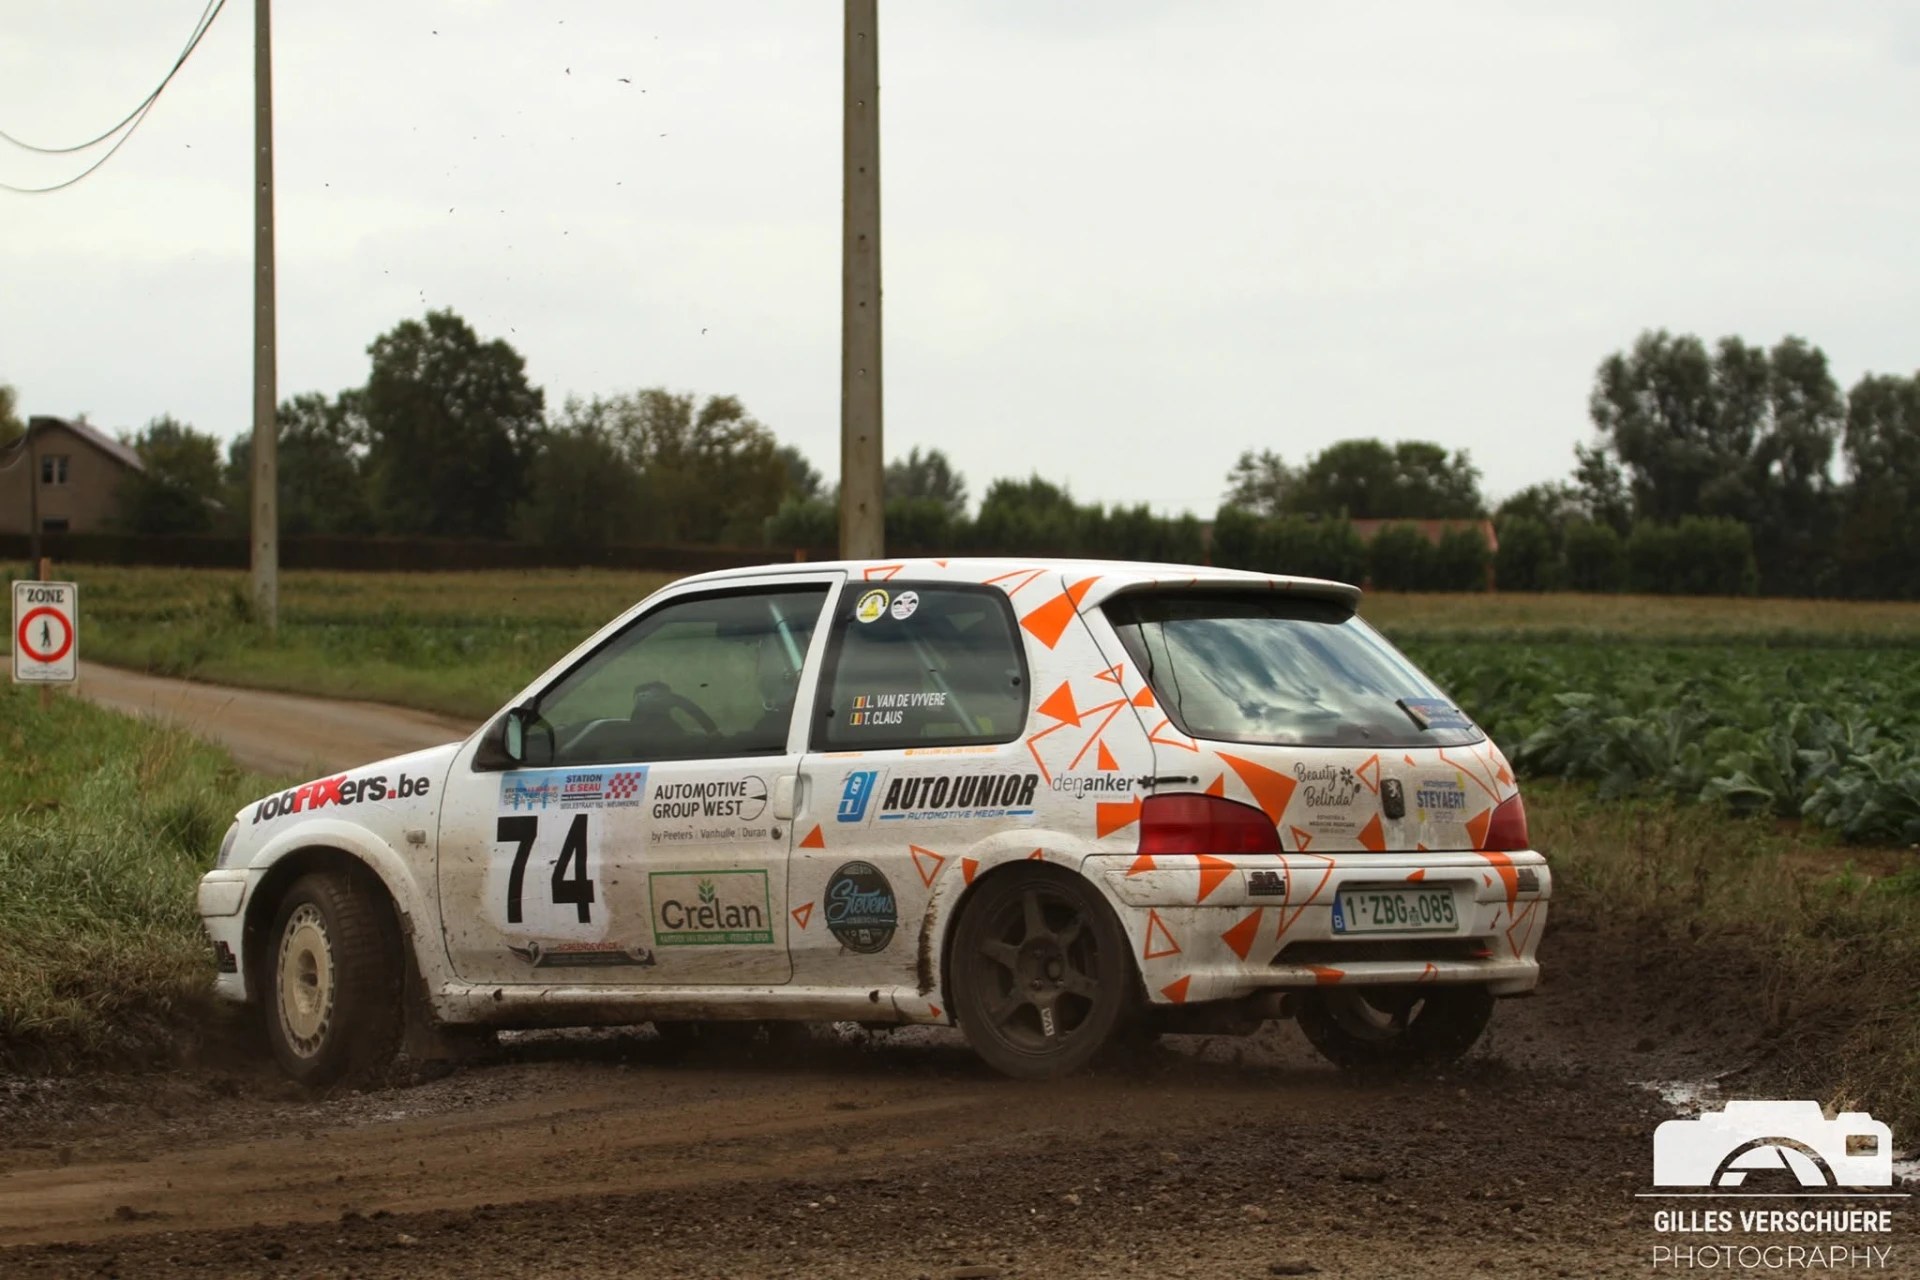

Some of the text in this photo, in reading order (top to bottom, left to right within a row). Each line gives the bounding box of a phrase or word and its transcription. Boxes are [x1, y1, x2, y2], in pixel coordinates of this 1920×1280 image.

[27, 588, 64, 603] ZONE
[865, 692, 948, 709] L. VAN DE VYVERE
[864, 711, 903, 725] T. CLAUS
[566, 774, 602, 783] STATION
[1294, 762, 1337, 791] Beauty
[565, 784, 576, 792] LE
[578, 783, 602, 792] SEAU
[654, 781, 748, 800] AUTOMOTIVE
[882, 774, 1039, 810] AUTOJUNIOR
[1303, 786, 1349, 807] Belinda
[1416, 790, 1465, 808] STEYAERT
[653, 800, 743, 819] GROUP WEST
[907, 808, 1005, 820] AUTOMOTIVE MEDIA
[652, 832, 662, 842] by
[663, 831, 693, 840] Peeters
[743, 827, 766, 837] Duran
[497, 814, 595, 924] 74
[662, 898, 762, 929] Crelan
